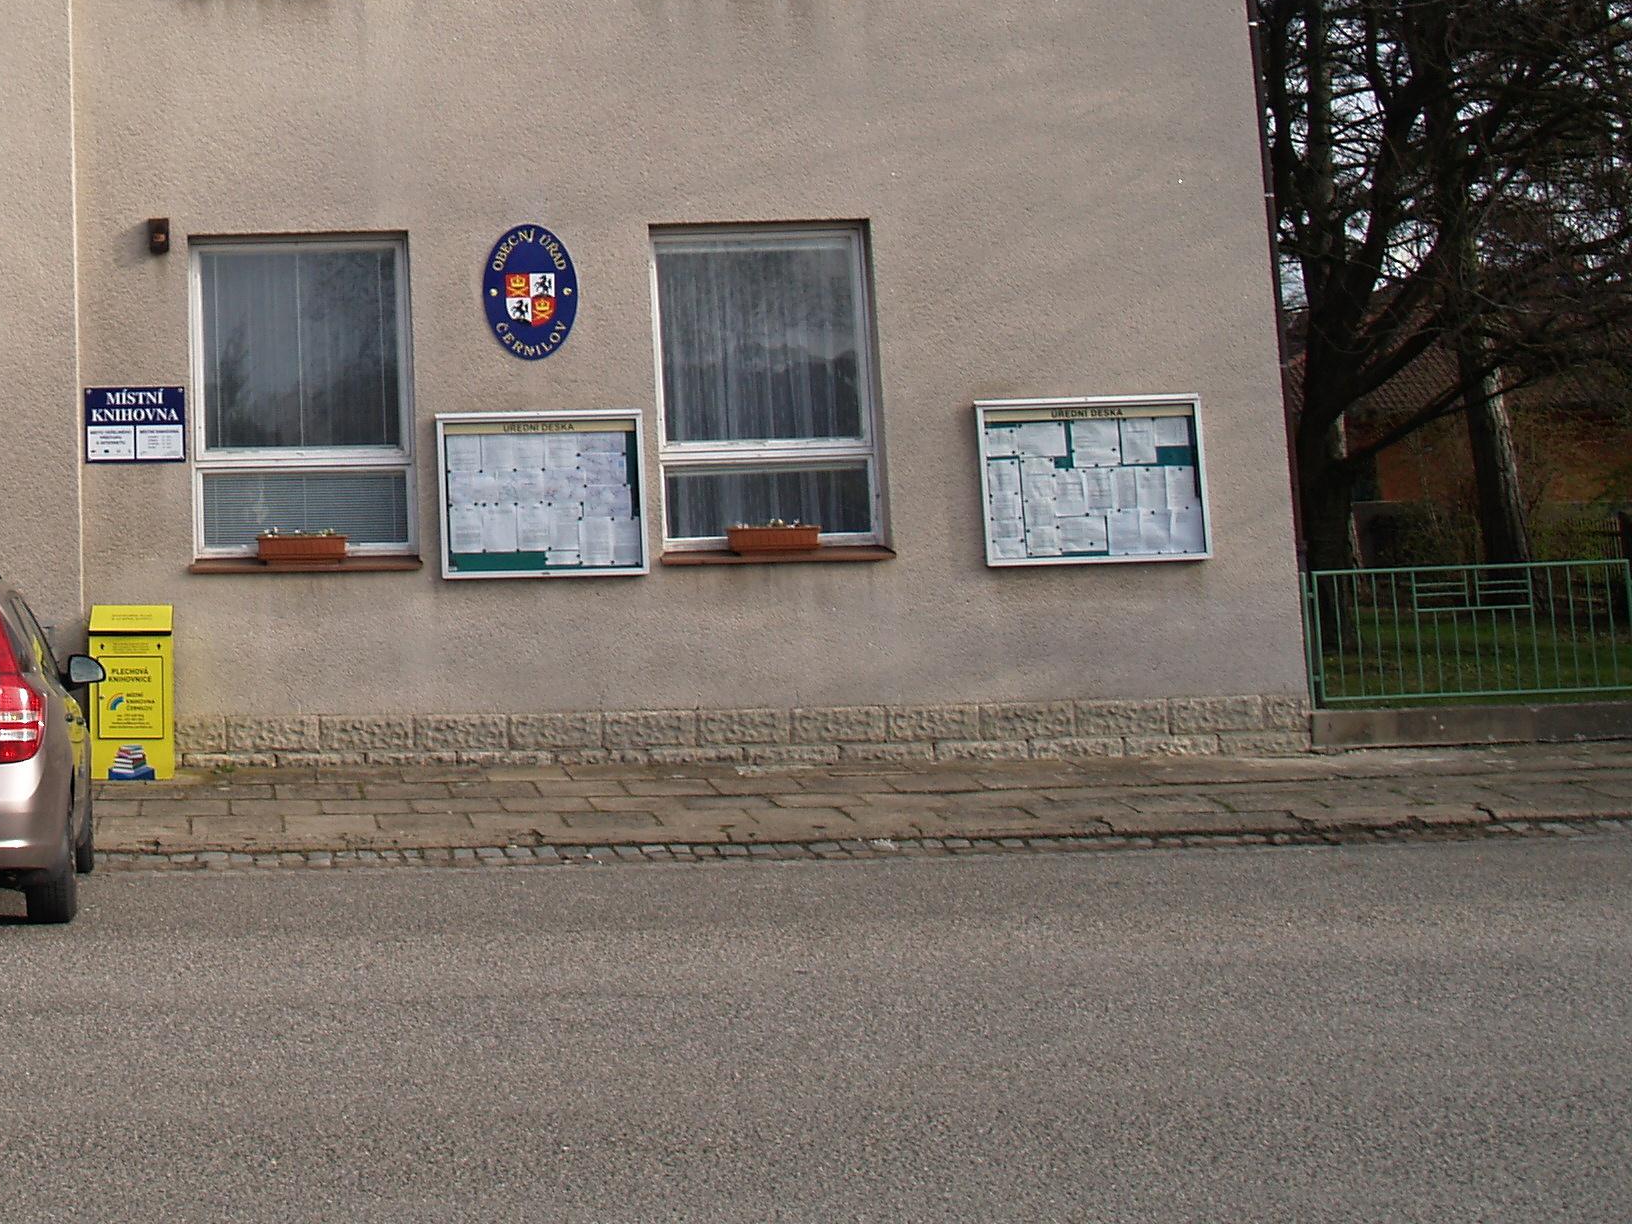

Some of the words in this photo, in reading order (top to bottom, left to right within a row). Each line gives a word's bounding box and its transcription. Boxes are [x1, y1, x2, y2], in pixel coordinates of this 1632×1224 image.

[492, 228, 535, 271] OBECNÍ
[539, 233, 566, 270] ÚŘAD
[496, 321, 566, 356] ČERNILOV
[106, 389, 164, 405] MÍSTNÍ
[91, 408, 179, 422] KNIHOVNA
[1090, 408, 1123, 417] DESKA
[542, 423, 575, 432] DESKA
